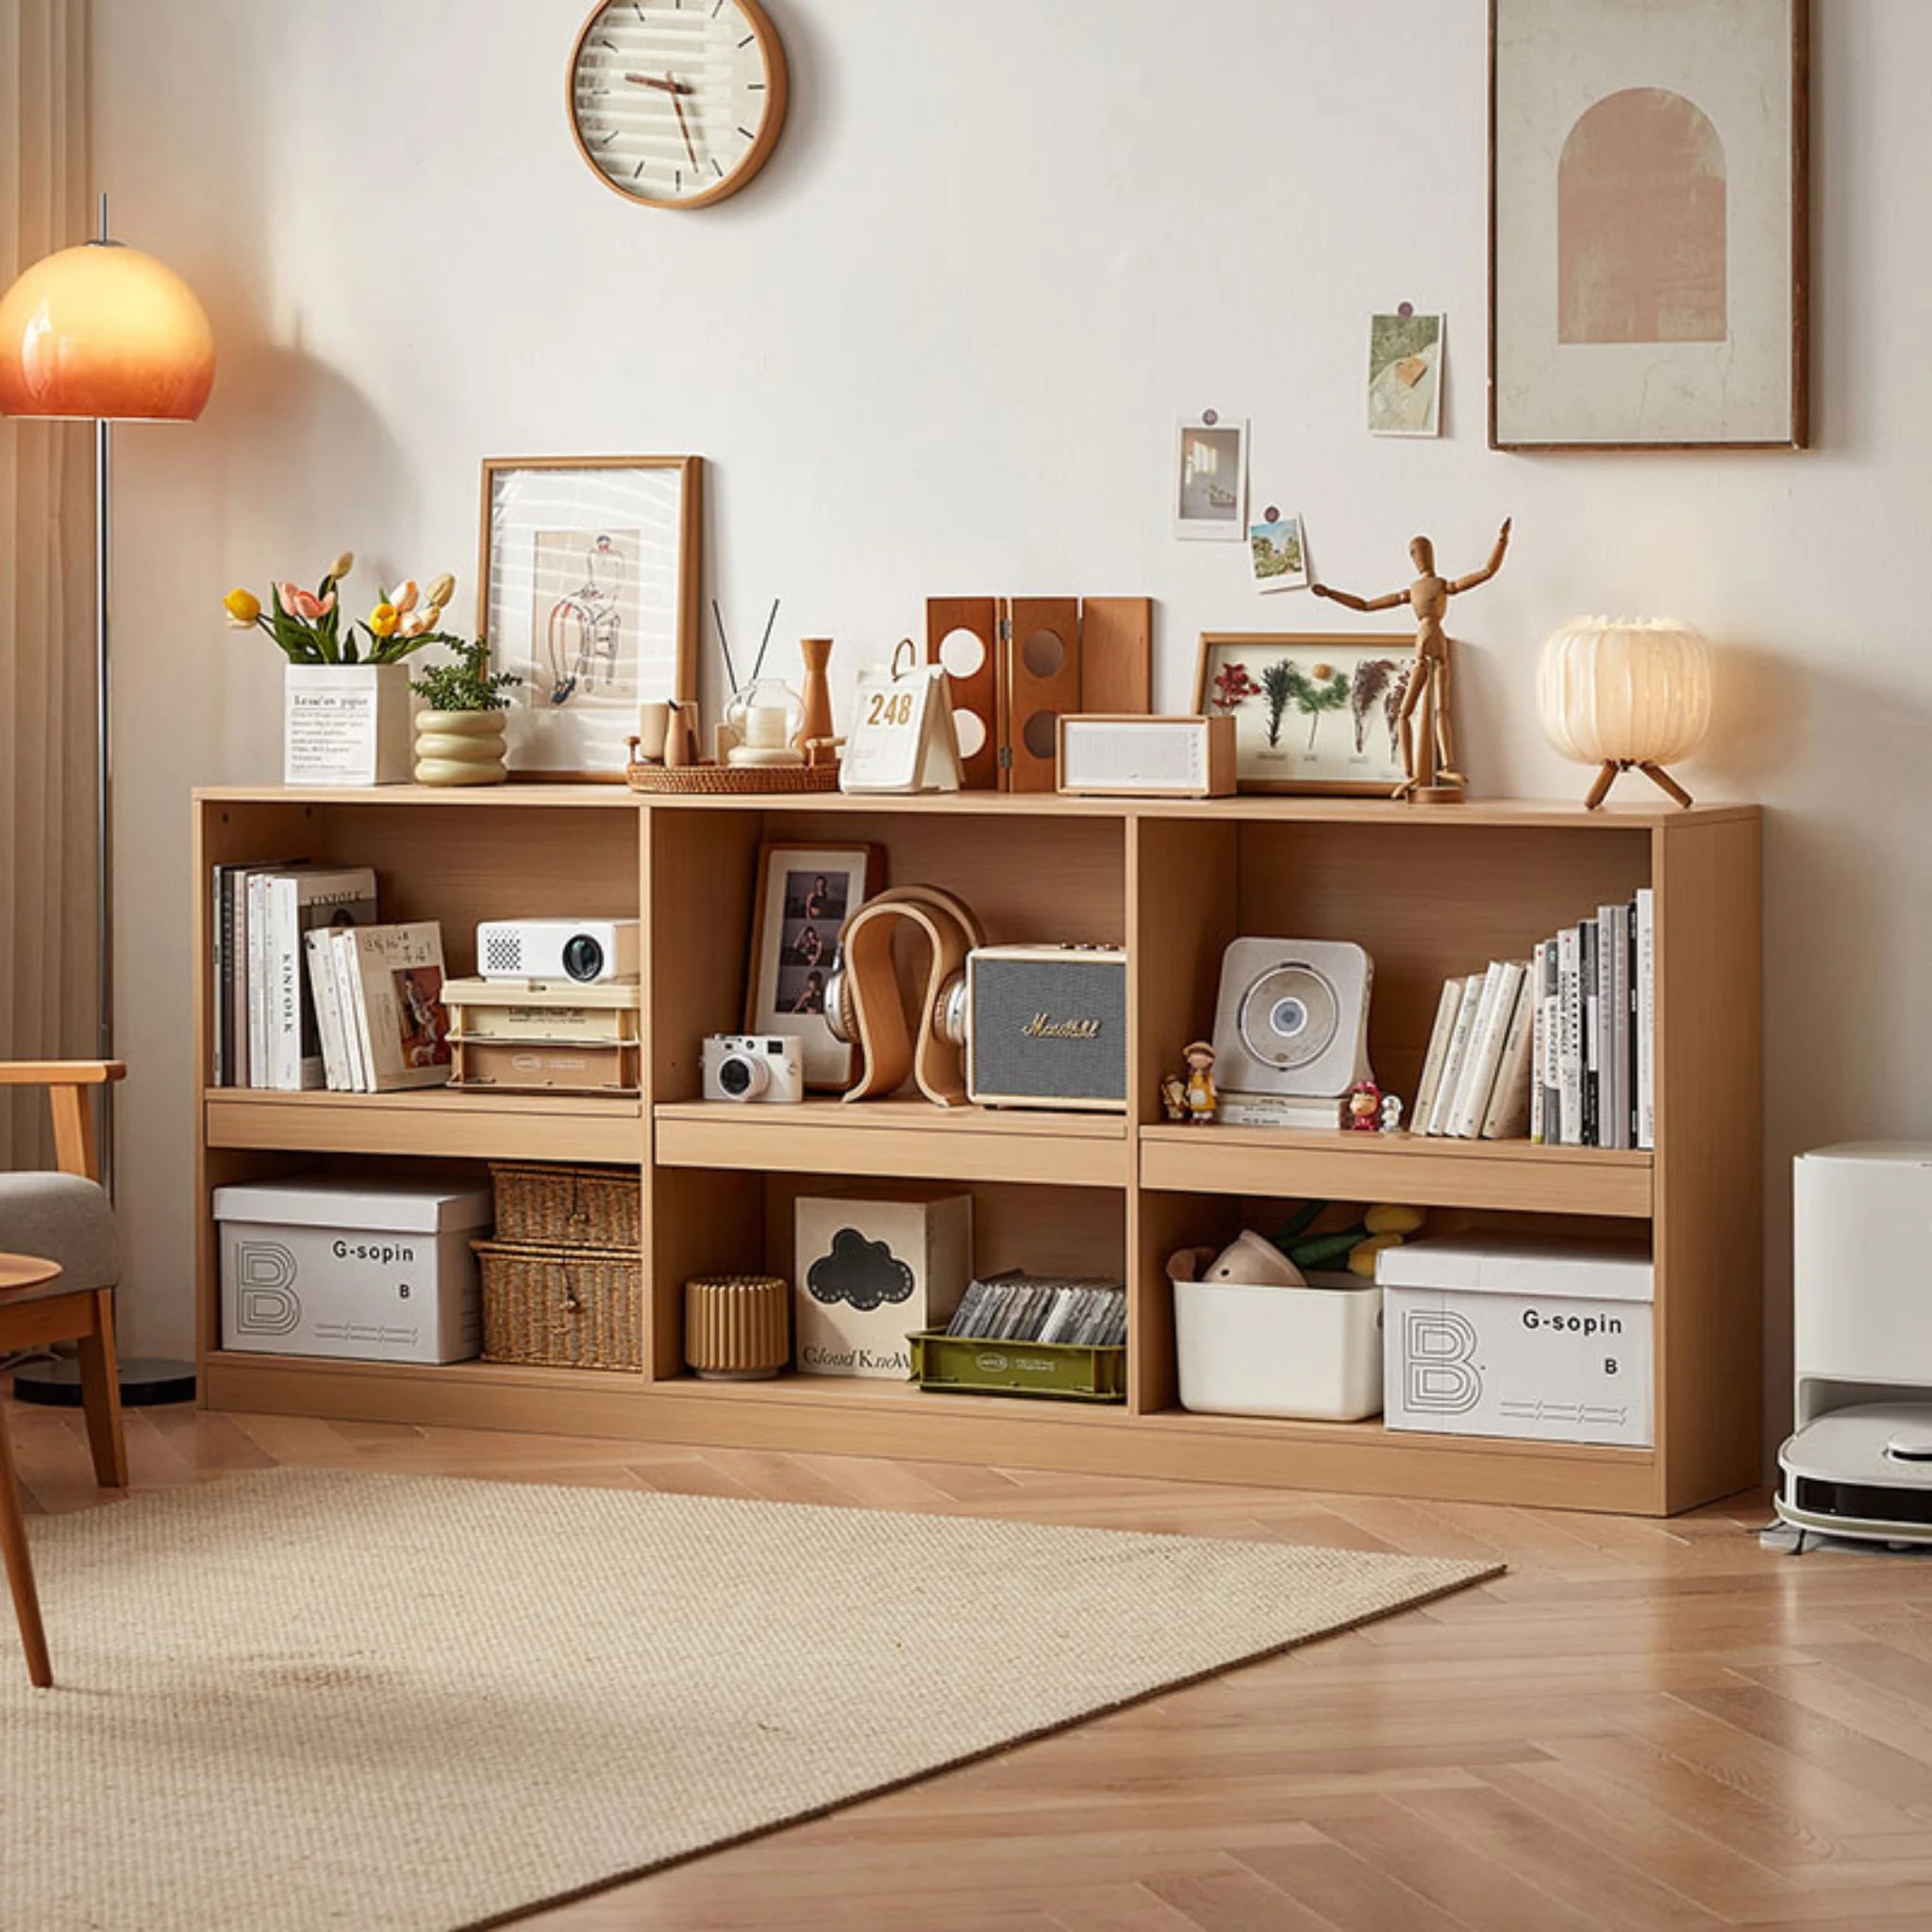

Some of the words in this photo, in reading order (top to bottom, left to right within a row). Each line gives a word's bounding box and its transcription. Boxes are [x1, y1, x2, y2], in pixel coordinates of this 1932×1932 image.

[867, 693, 913, 725] 248
[283, 953, 293, 1033] KINFOLK
[332, 1240, 414, 1265] G-sopin
[399, 1284, 409, 1299] B
[1523, 1308, 1623, 1337] G-sopin
[1605, 1357, 1618, 1375] B
